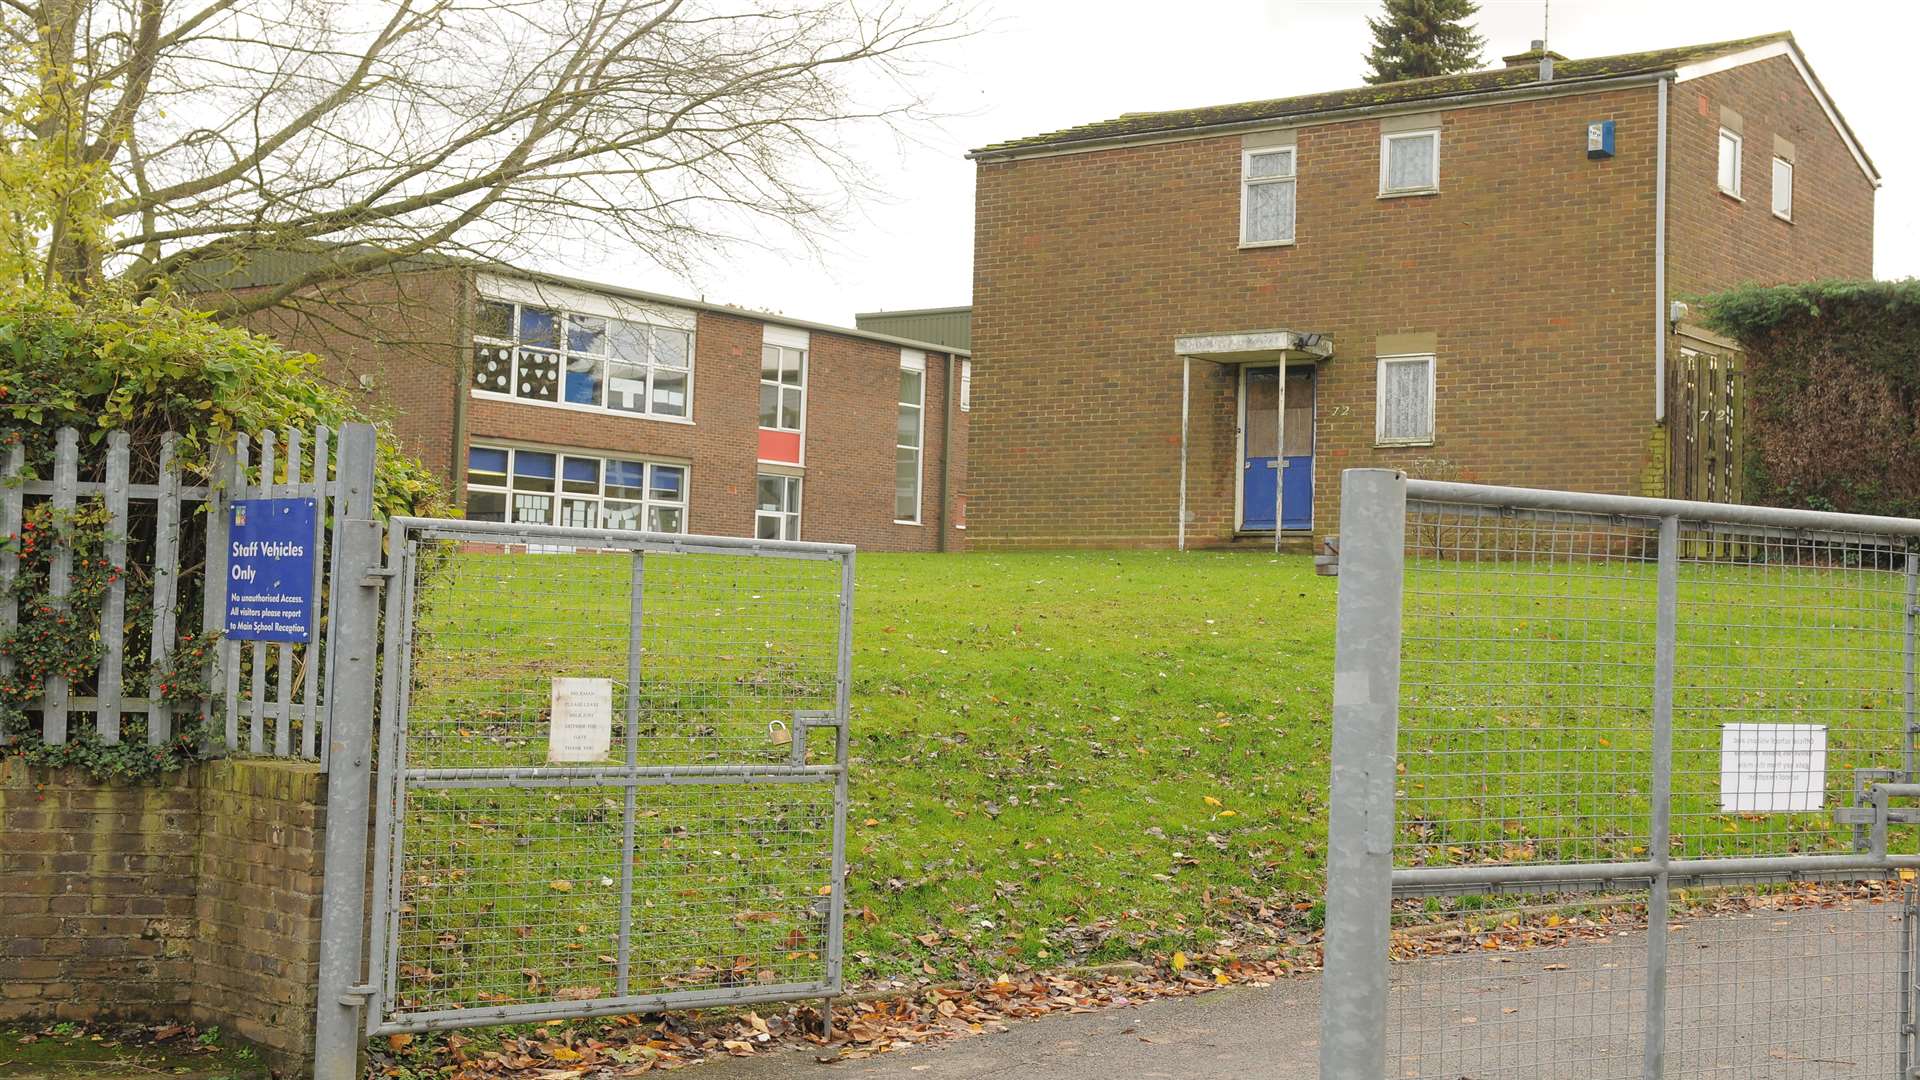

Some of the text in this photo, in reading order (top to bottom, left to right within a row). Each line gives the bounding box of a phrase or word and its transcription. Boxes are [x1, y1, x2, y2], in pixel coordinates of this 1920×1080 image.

[1331, 406, 1350, 416] 72
[232, 541, 304, 558] Staff Vehicles
[232, 564, 256, 584] Only
[231, 592, 304, 603] No unauthorised Access.
[230, 606, 302, 619] All visitors please report
[230, 622, 304, 634] to Main School Reception
